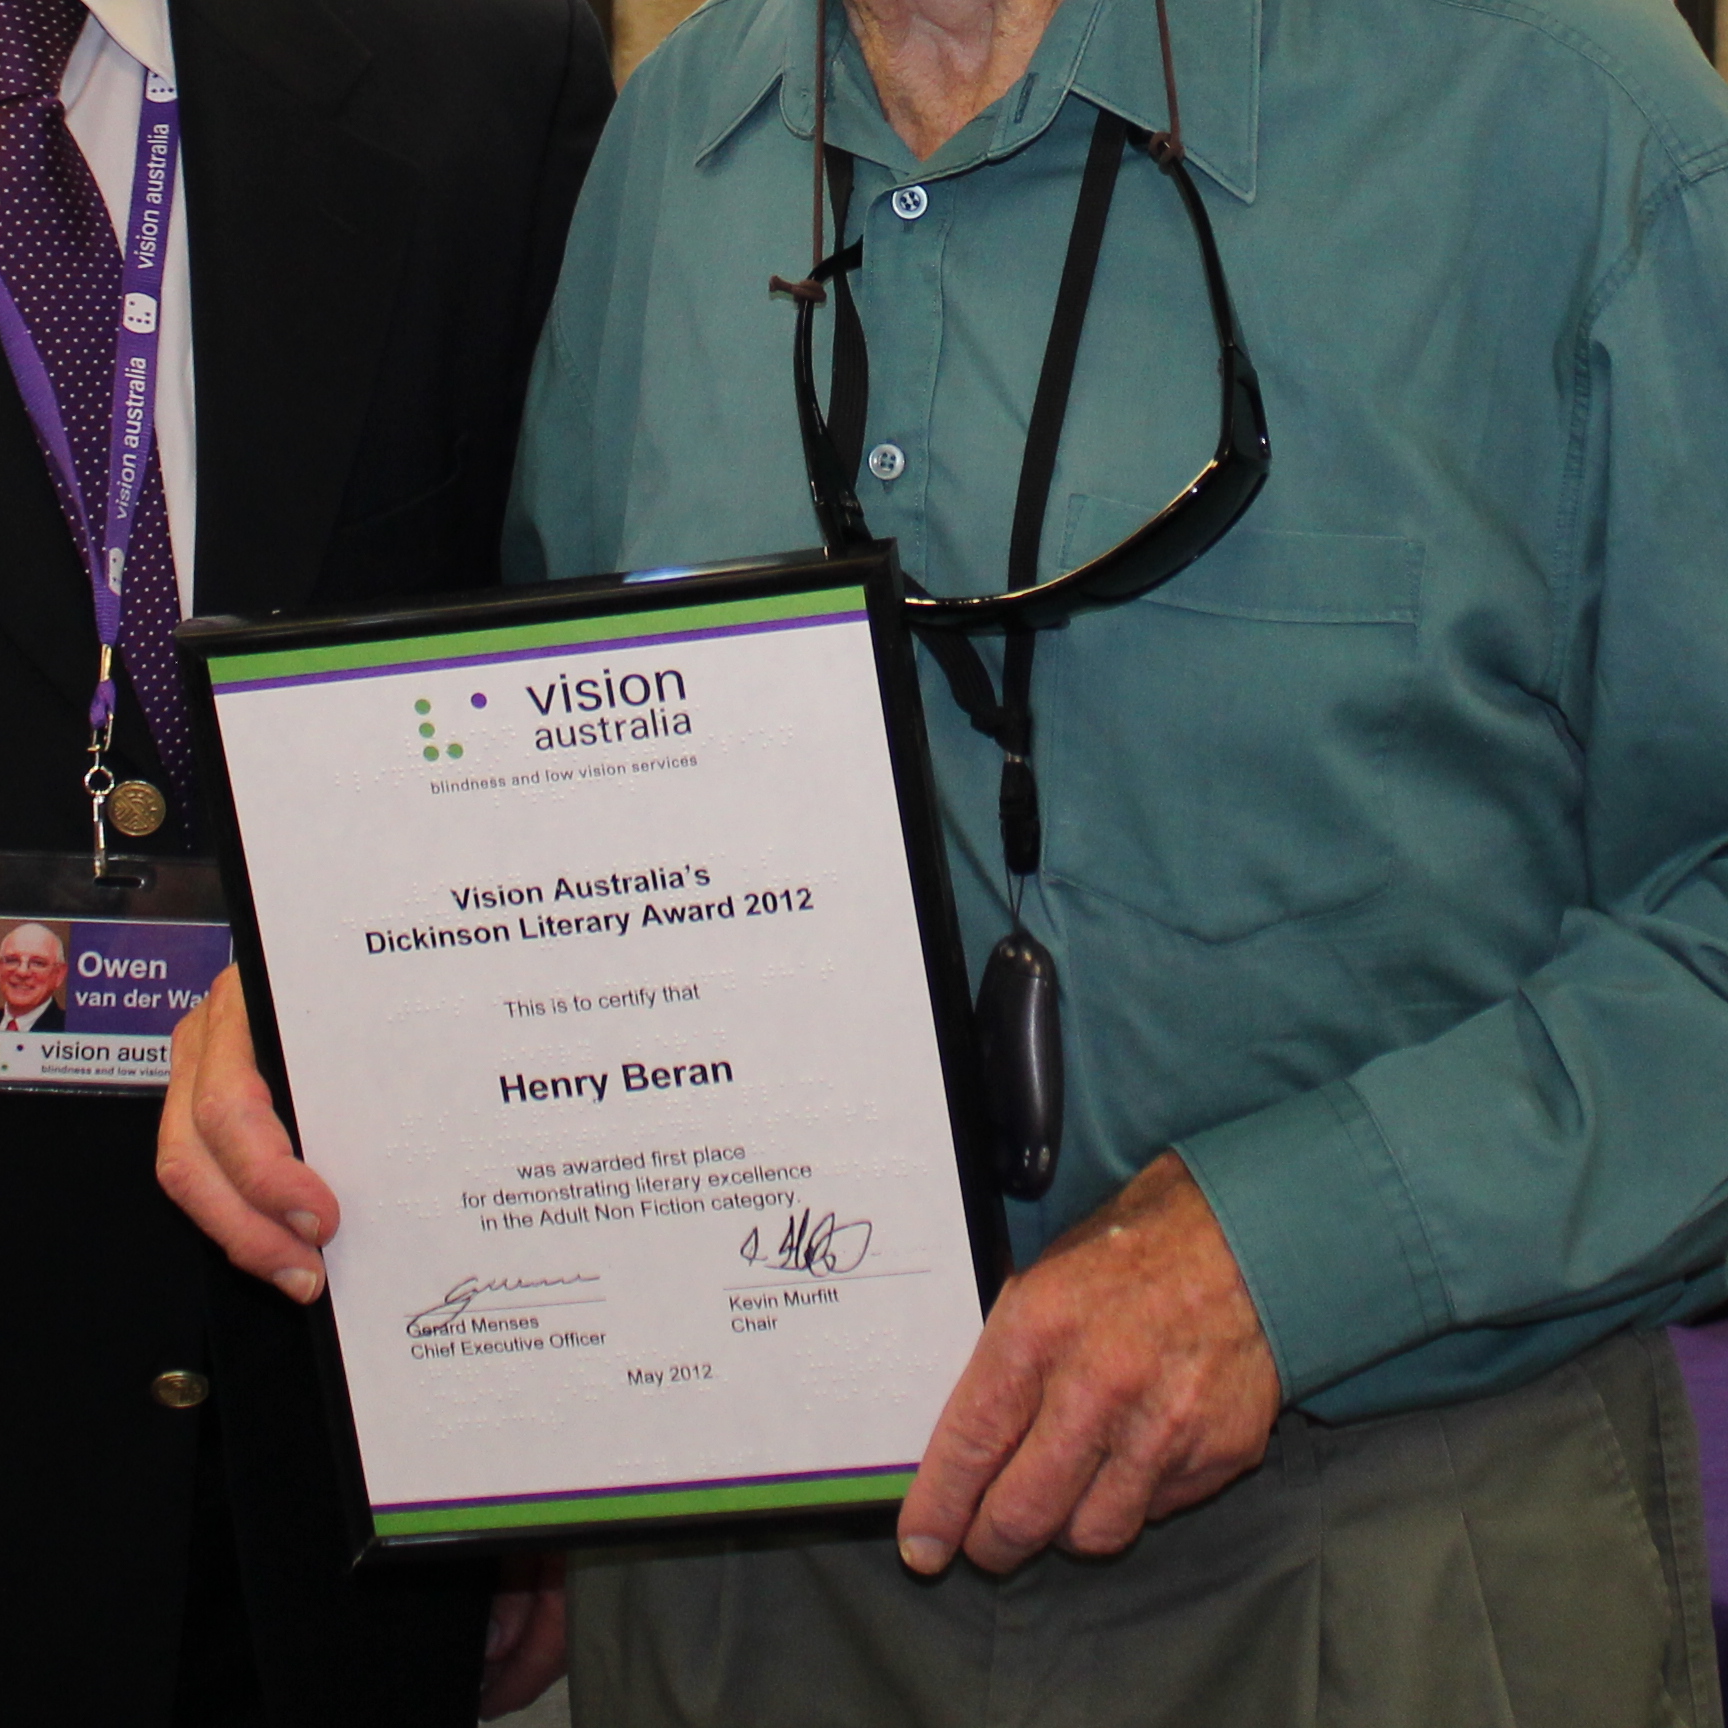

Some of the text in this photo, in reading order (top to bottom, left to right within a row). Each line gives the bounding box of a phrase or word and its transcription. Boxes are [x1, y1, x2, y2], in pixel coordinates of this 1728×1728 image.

[135, 122, 170, 271] vision australia
[115, 356, 149, 521] vision australia
[526, 666, 688, 718] vision
[533, 706, 693, 752] australia
[430, 755, 699, 796] blindness and low vision services
[451, 863, 711, 912] Vision Australia's
[365, 887, 815, 956] Dickinson Literary Award 2012
[77, 951, 168, 980] Owen
[75, 990, 117, 1007] van
[123, 989, 162, 1008] der
[504, 983, 701, 1020] This is to certify that
[42, 1040, 110, 1061] vision
[498, 1055, 734, 1104] Henry Beran
[516, 1145, 747, 1180] was awarded first place
[462, 1162, 813, 1210] for demonstrating literary excellence
[480, 1188, 802, 1232] in the Adult Non Fiction category.
[729, 1287, 840, 1312] Kevin Murfitt
[406, 1316, 540, 1339] Gerard Menses
[731, 1315, 779, 1333] Chair
[410, 1332, 607, 1361] Chief Executive Officer
[626, 1363, 714, 1387] May 2012
